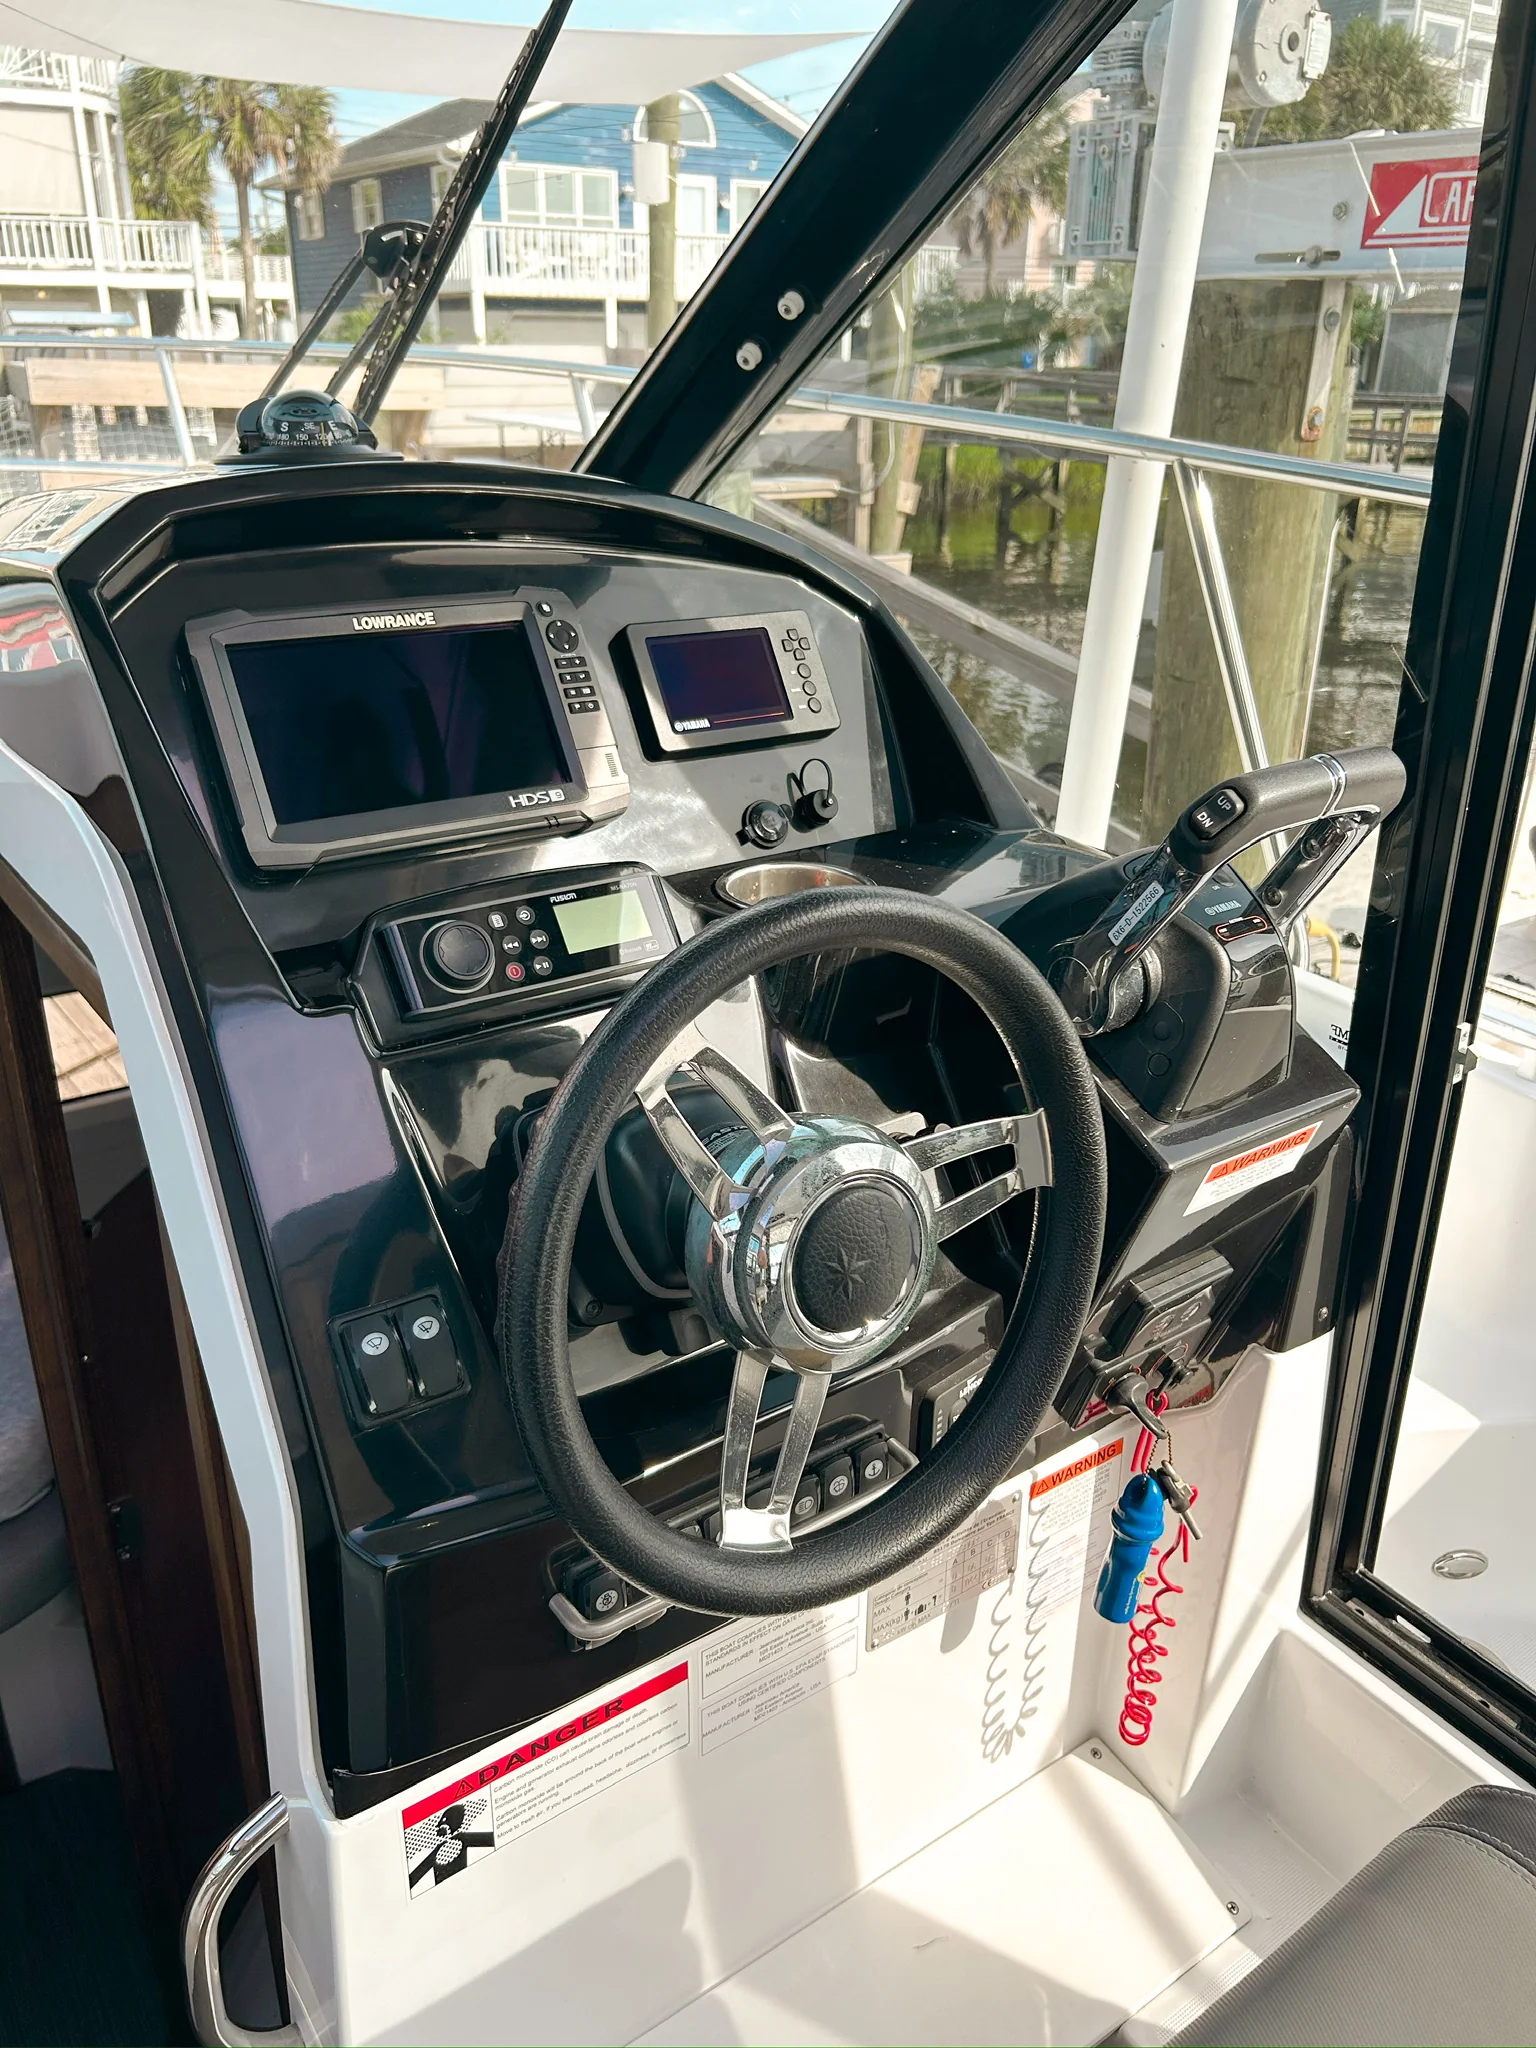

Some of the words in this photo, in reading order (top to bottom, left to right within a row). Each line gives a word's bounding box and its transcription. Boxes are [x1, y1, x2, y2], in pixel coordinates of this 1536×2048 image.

[281, 421, 289, 432] S
[295, 433, 309, 441] 150
[304, 422, 315, 430] SE
[352, 611, 436, 631] LOWRANCE
[509, 791, 549, 808] HDS
[1217, 796, 1232, 811] UP
[1197, 811, 1214, 828] DN
[1112, 886, 1160, 941] 6X6-D-1522566
[1212, 900, 1242, 914] YAMAHA
[1231, 1130, 1307, 1172] WARNING
[1051, 1444, 1116, 1486] WARNING
[987, 1538, 992, 1547] C
[1004, 1529, 1010, 1538] D
[952, 1557, 957, 1565] A
[970, 1547, 975, 1556] B
[873, 1603, 890, 1619] MAX
[787, 1631, 810, 1647] Annapolis
[815, 1623, 826, 1632] USA
[873, 1612, 903, 1636] MAX(kg)
[705, 1649, 718, 1660] THIS
[720, 1640, 735, 1652] BOAT
[737, 1624, 765, 1643] COMPLIES
[767, 1616, 781, 1628] WITH
[705, 1643, 740, 1666] STANDARDS
[749, 1628, 770, 1643] EFFECT
[772, 1623, 780, 1631] ON
[782, 1614, 796, 1626] DATE
[769, 1636, 788, 1650] Eastern
[790, 1627, 808, 1640] Avenue
[705, 1649, 753, 1678] MANUFACTURER
[759, 1634, 782, 1650] Jeanneau
[784, 1623, 804, 1636] America
[707, 1707, 719, 1717] THIS
[721, 1698, 736, 1710] BOAT
[738, 1681, 767, 1700] COMPLIES
[768, 1673, 782, 1685] WITH
[795, 1660, 806, 1670] EPA
[738, 1693, 755, 1706] USING
[757, 1677, 786, 1696] CERTIFIED
[787, 1656, 825, 1680] COMPONENTS
[782, 1689, 805, 1706] Annapolis
[810, 1680, 821, 1690] USA
[702, 1708, 749, 1738] MANUFACTURER
[754, 1692, 778, 1709] Jeanneau
[779, 1681, 799, 1696] America
[764, 1695, 783, 1710] Eastern
[784, 1685, 802, 1699] Avenue
[479, 1696, 623, 1785] DANGER
[493, 1777, 514, 1793] Carbon
[516, 1762, 543, 1781] monoxide
[544, 1753, 558, 1766] (CO)
[559, 1749, 568, 1757] can
[570, 1739, 587, 1751] cause
[588, 1731, 601, 1742] brain
[603, 1719, 624, 1735] damage
[494, 1788, 514, 1805] Engine
[515, 1782, 526, 1792] and
[528, 1767, 553, 1786] generator
[555, 1755, 577, 1771] exhaust
[578, 1742, 600, 1759] contains
[601, 1730, 623, 1746] odorless
[625, 1724, 635, 1733] and
[636, 1711, 658, 1728] colorless
[660, 1701, 677, 1715] carbon
[495, 1806, 516, 1822] Carbon
[518, 1790, 545, 1809] monoxide
[546, 1785, 554, 1794] will
[564, 1769, 583, 1783] around
[584, 1764, 593, 1772] the
[594, 1757, 606, 1767] back
[614, 1748, 623, 1756] the
[624, 1741, 635, 1751] boat
[636, 1733, 649, 1744] when
[652, 1722, 671, 1737] engines
[494, 1791, 522, 1811] monoxide
[496, 1808, 526, 1829] generators
[527, 1803, 536, 1811] are
[497, 1826, 512, 1839] Move
[520, 1814, 534, 1826] fresh
[550, 1800, 561, 1810] you
[562, 1793, 572, 1803] feel
